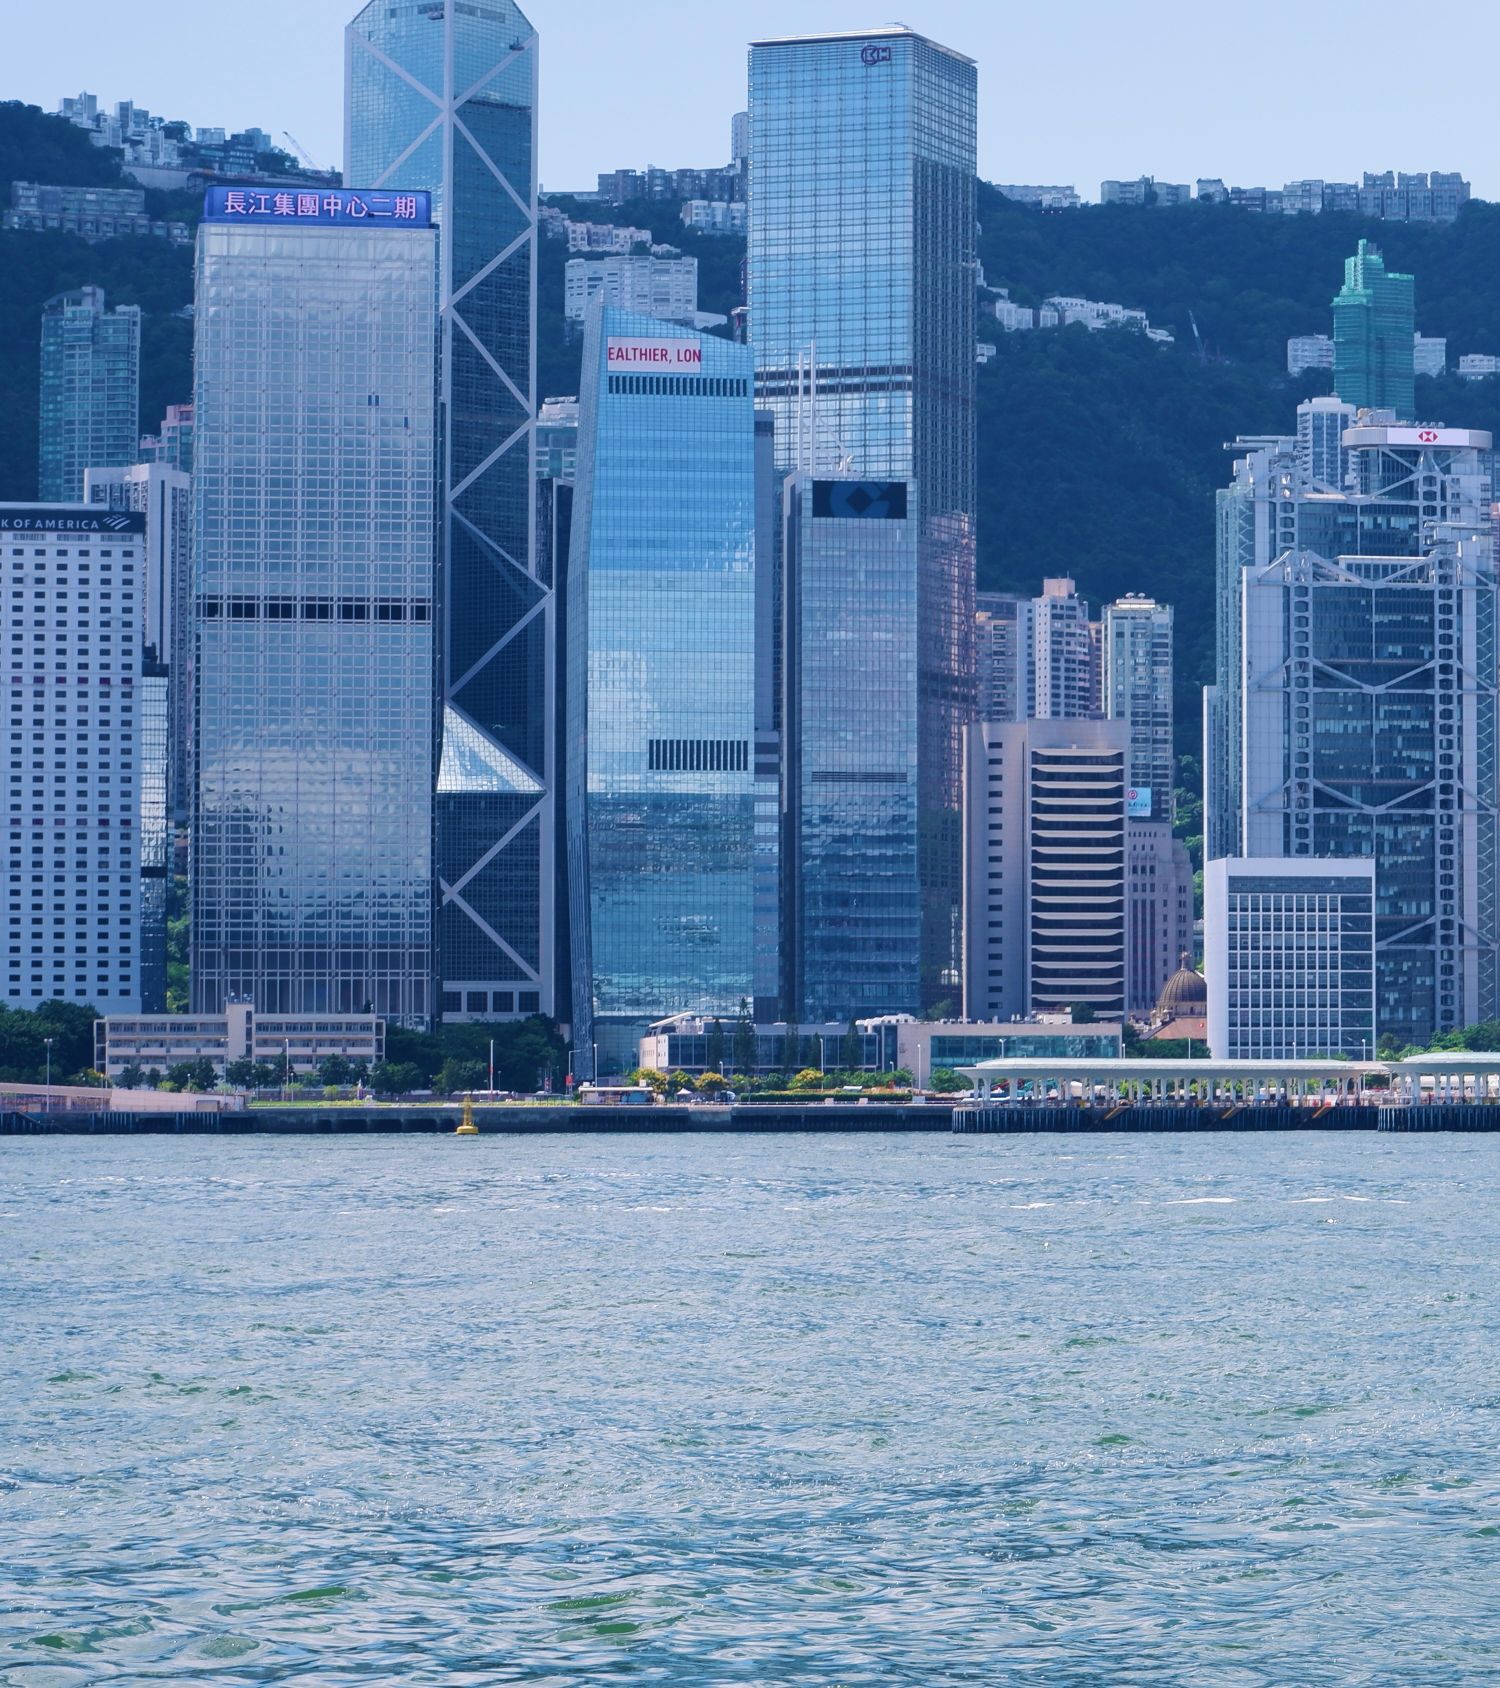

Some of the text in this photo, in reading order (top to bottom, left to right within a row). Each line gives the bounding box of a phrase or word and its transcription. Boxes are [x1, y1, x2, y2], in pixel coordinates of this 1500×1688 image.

[225, 192, 416, 219] 長江集團中心二期
[608, 347, 702, 364] EALTHIER, LON
[13, 519, 31, 529] OF
[34, 520, 100, 530] AMERICA
